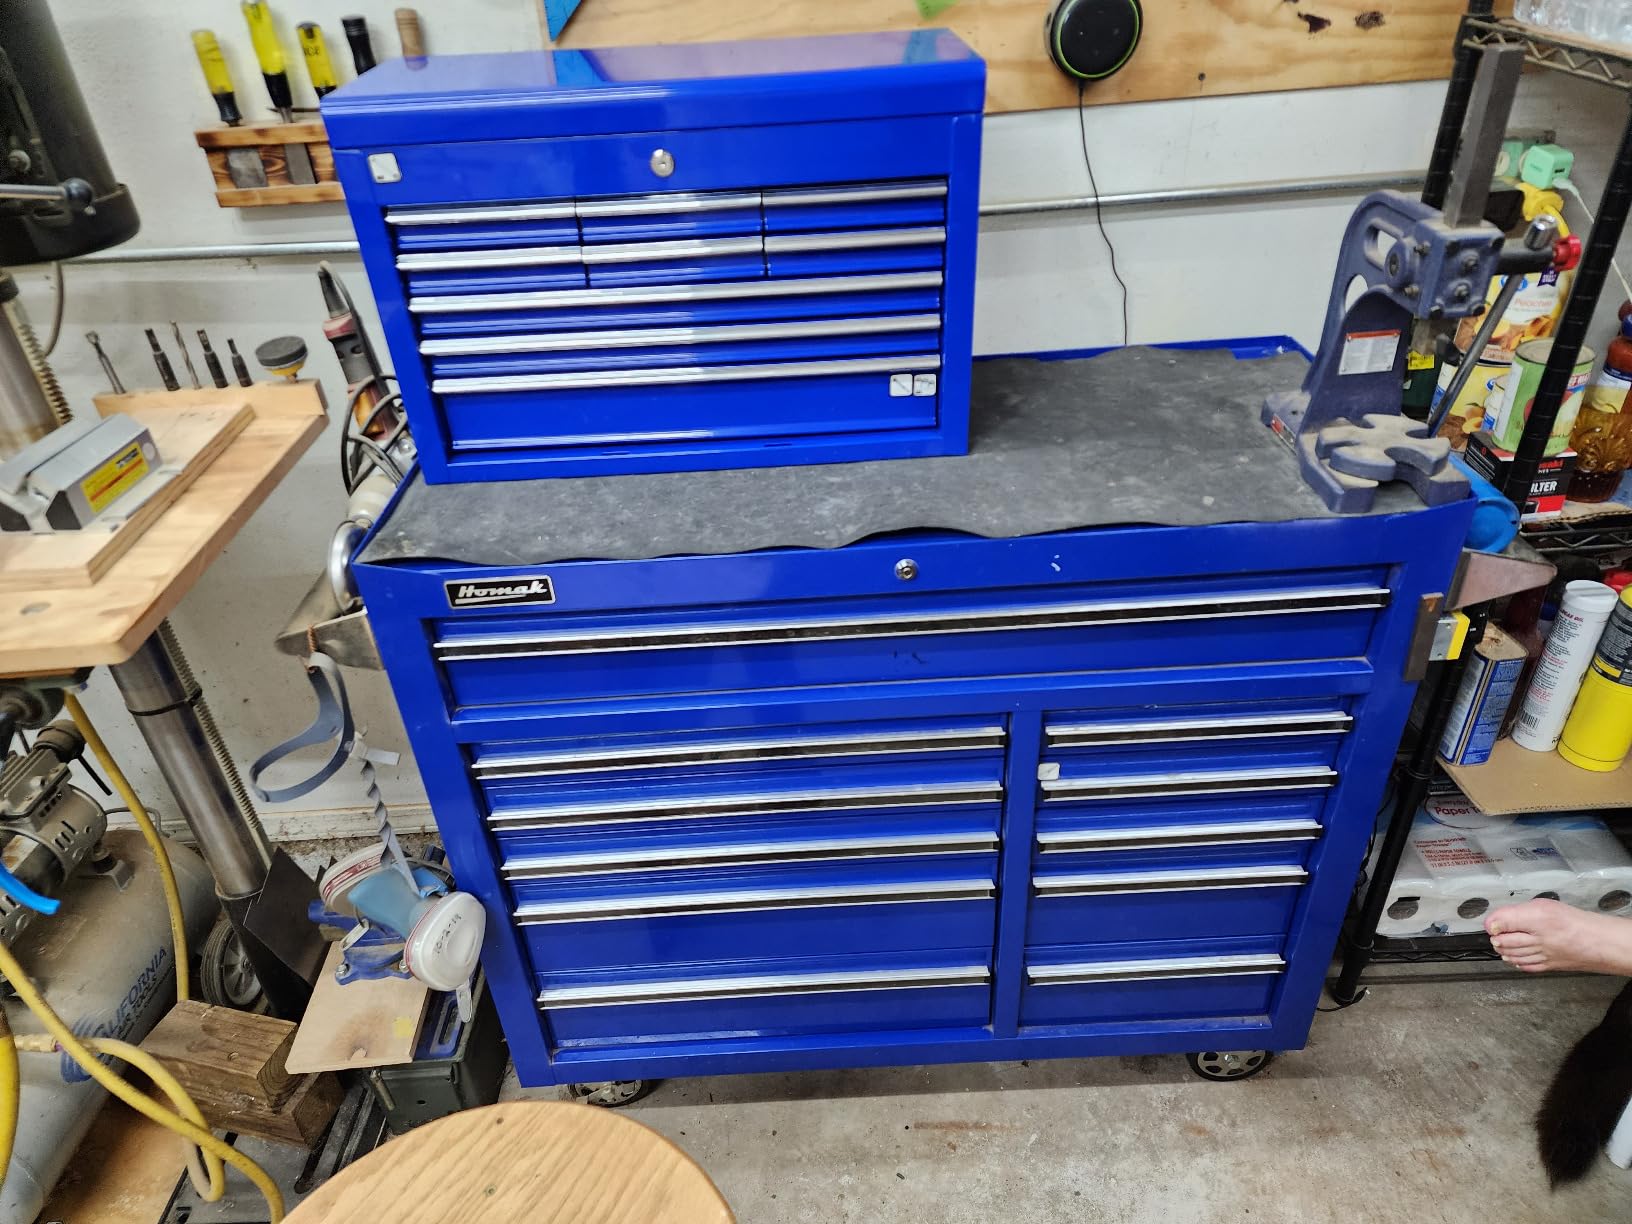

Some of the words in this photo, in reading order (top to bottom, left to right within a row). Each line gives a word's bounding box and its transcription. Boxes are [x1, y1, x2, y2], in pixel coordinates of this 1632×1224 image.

[1530, 480, 1558, 493] ILTER
[458, 580, 548, 598] Homak
[1434, 806, 1470, 816] Paper
